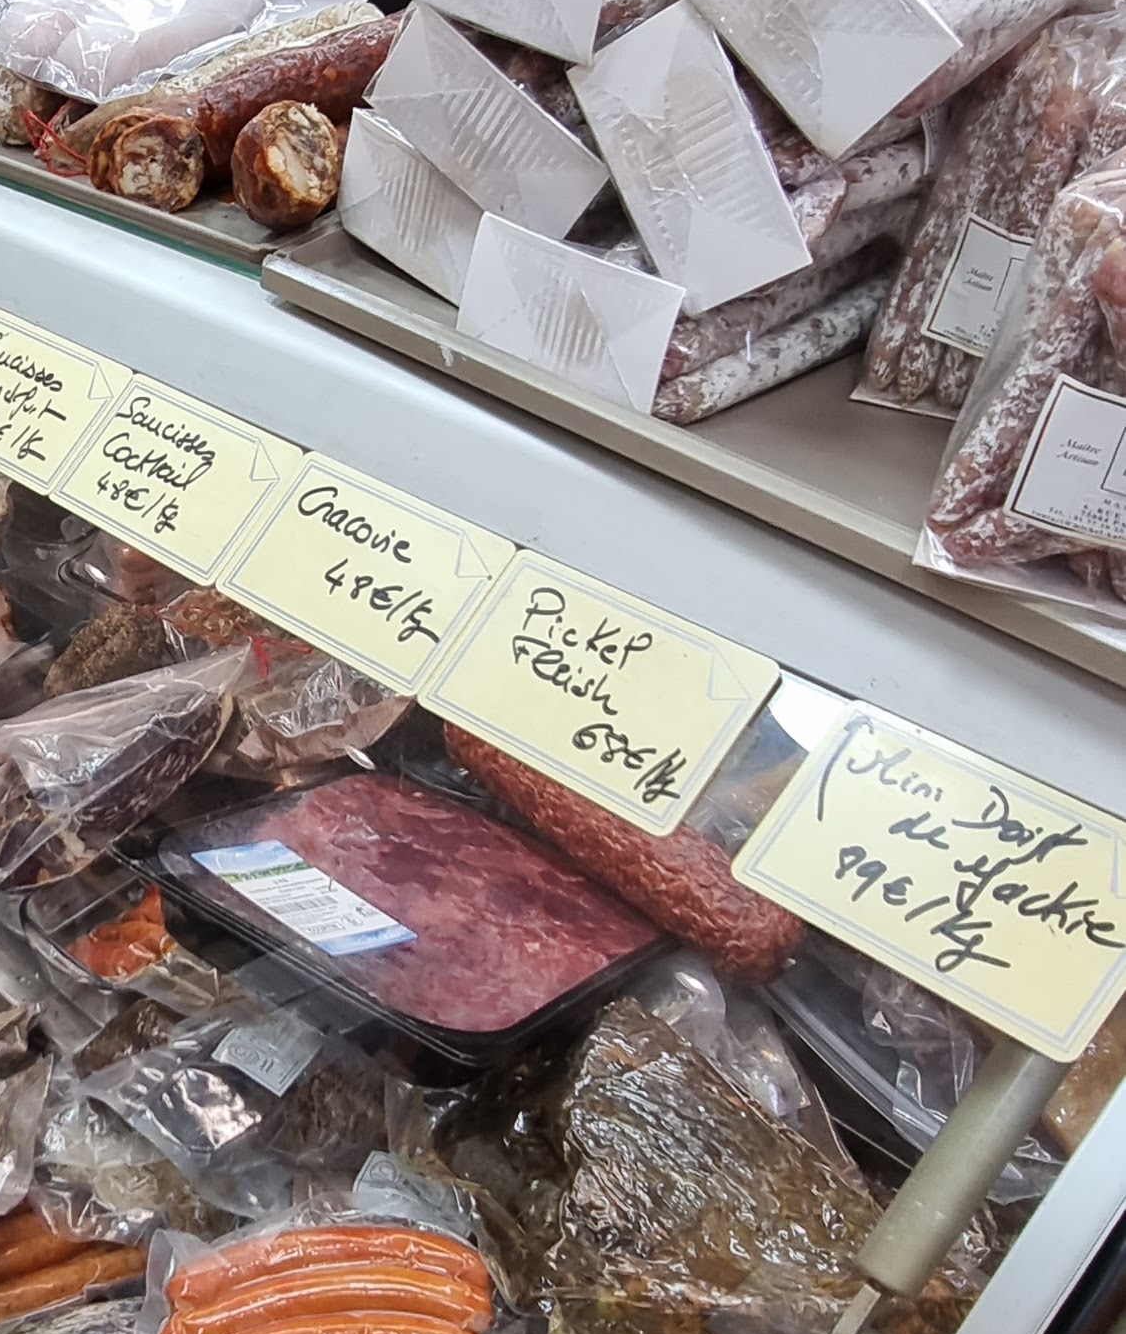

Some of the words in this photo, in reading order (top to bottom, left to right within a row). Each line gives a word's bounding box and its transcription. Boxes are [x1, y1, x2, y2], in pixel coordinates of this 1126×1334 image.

[115, 395, 217, 463] Saucisses
[1059, 438, 1102, 455] Maître
[101, 431, 214, 493] Cocktail
[1056, 450, 1100, 467] Artisan
[296, 485, 414, 565] Cracovie
[888, 811, 951, 850] de
